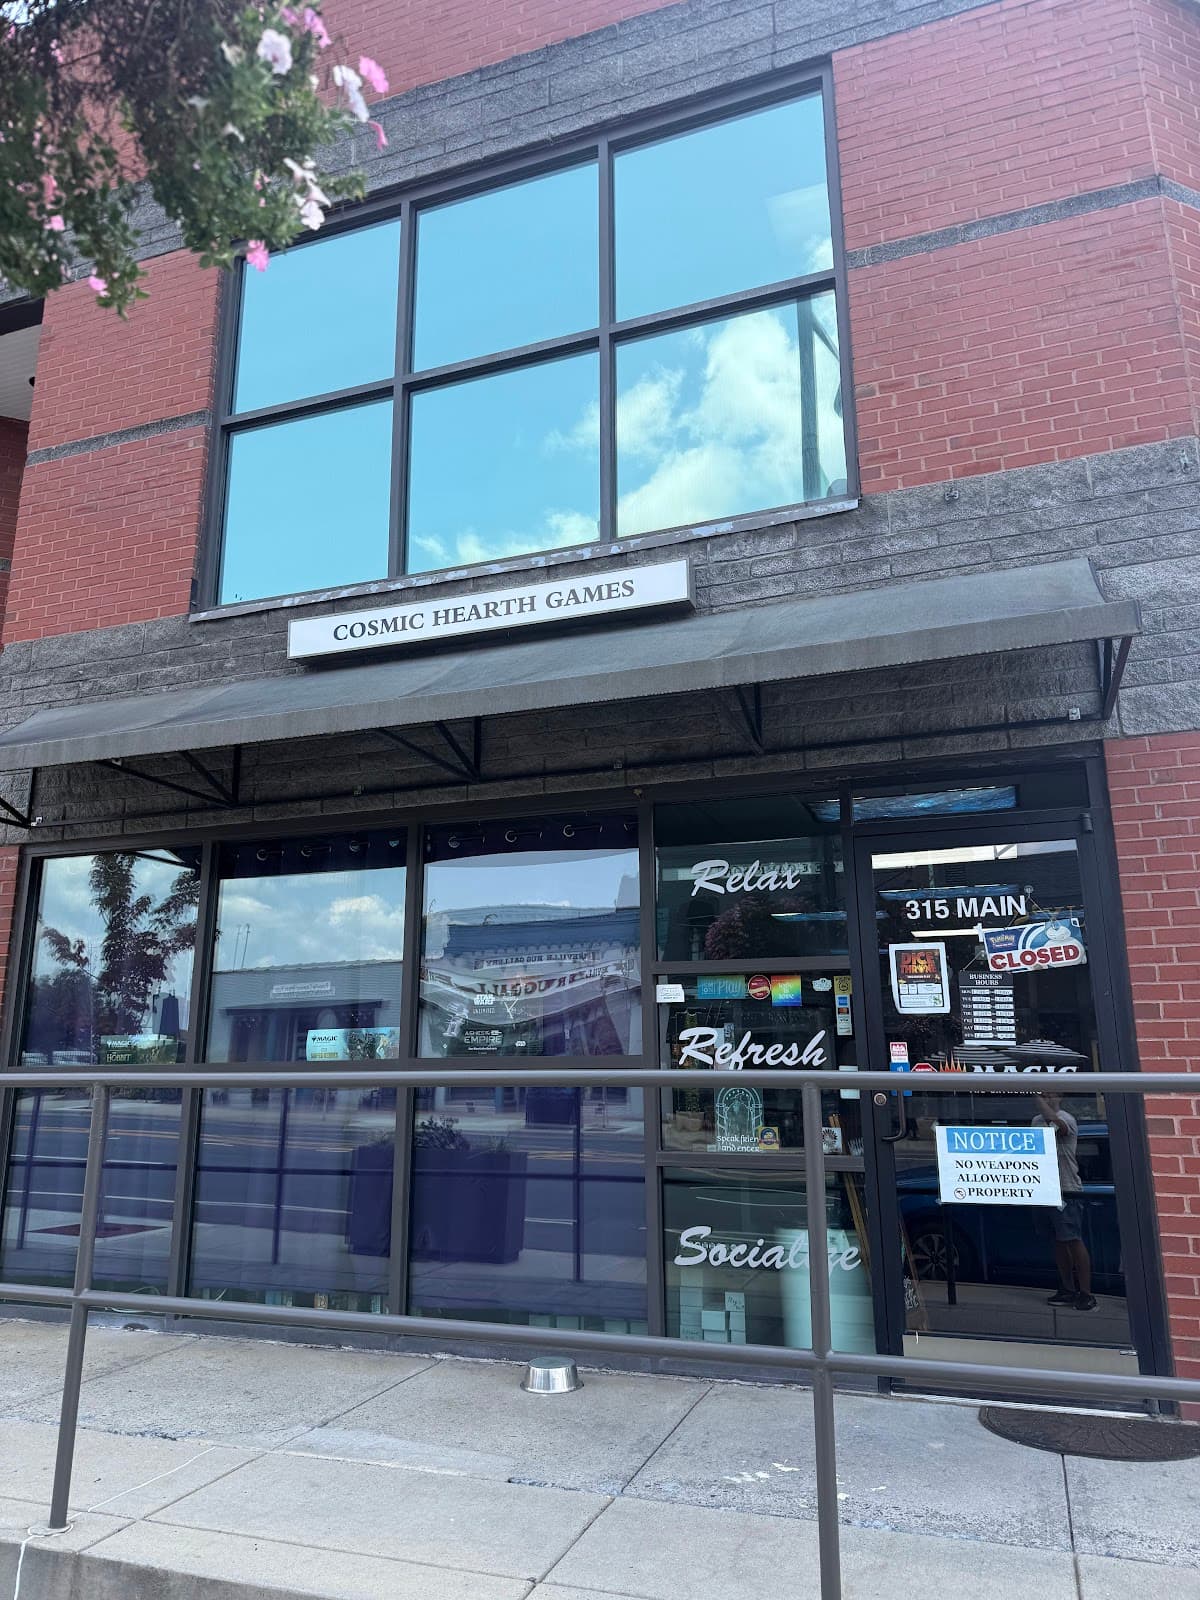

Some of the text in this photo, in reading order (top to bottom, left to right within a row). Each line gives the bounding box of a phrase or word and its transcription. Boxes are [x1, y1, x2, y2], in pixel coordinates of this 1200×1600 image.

[333, 579, 635, 641] COSMIC HEARTH GAMES
[691, 859, 801, 897] Relax
[905, 895, 1027, 920] 315 MAIN
[990, 944, 1080, 970] CLOSED
[464, 1036, 502, 1044] EMPIRE
[678, 1026, 828, 1070] Refresh
[953, 1131, 1036, 1151] NOTICE
[955, 1160, 1039, 1170] NO WEAPONS
[957, 1173, 1041, 1184] ALLOWED ON
[968, 1187, 1034, 1198] PROPERTY
